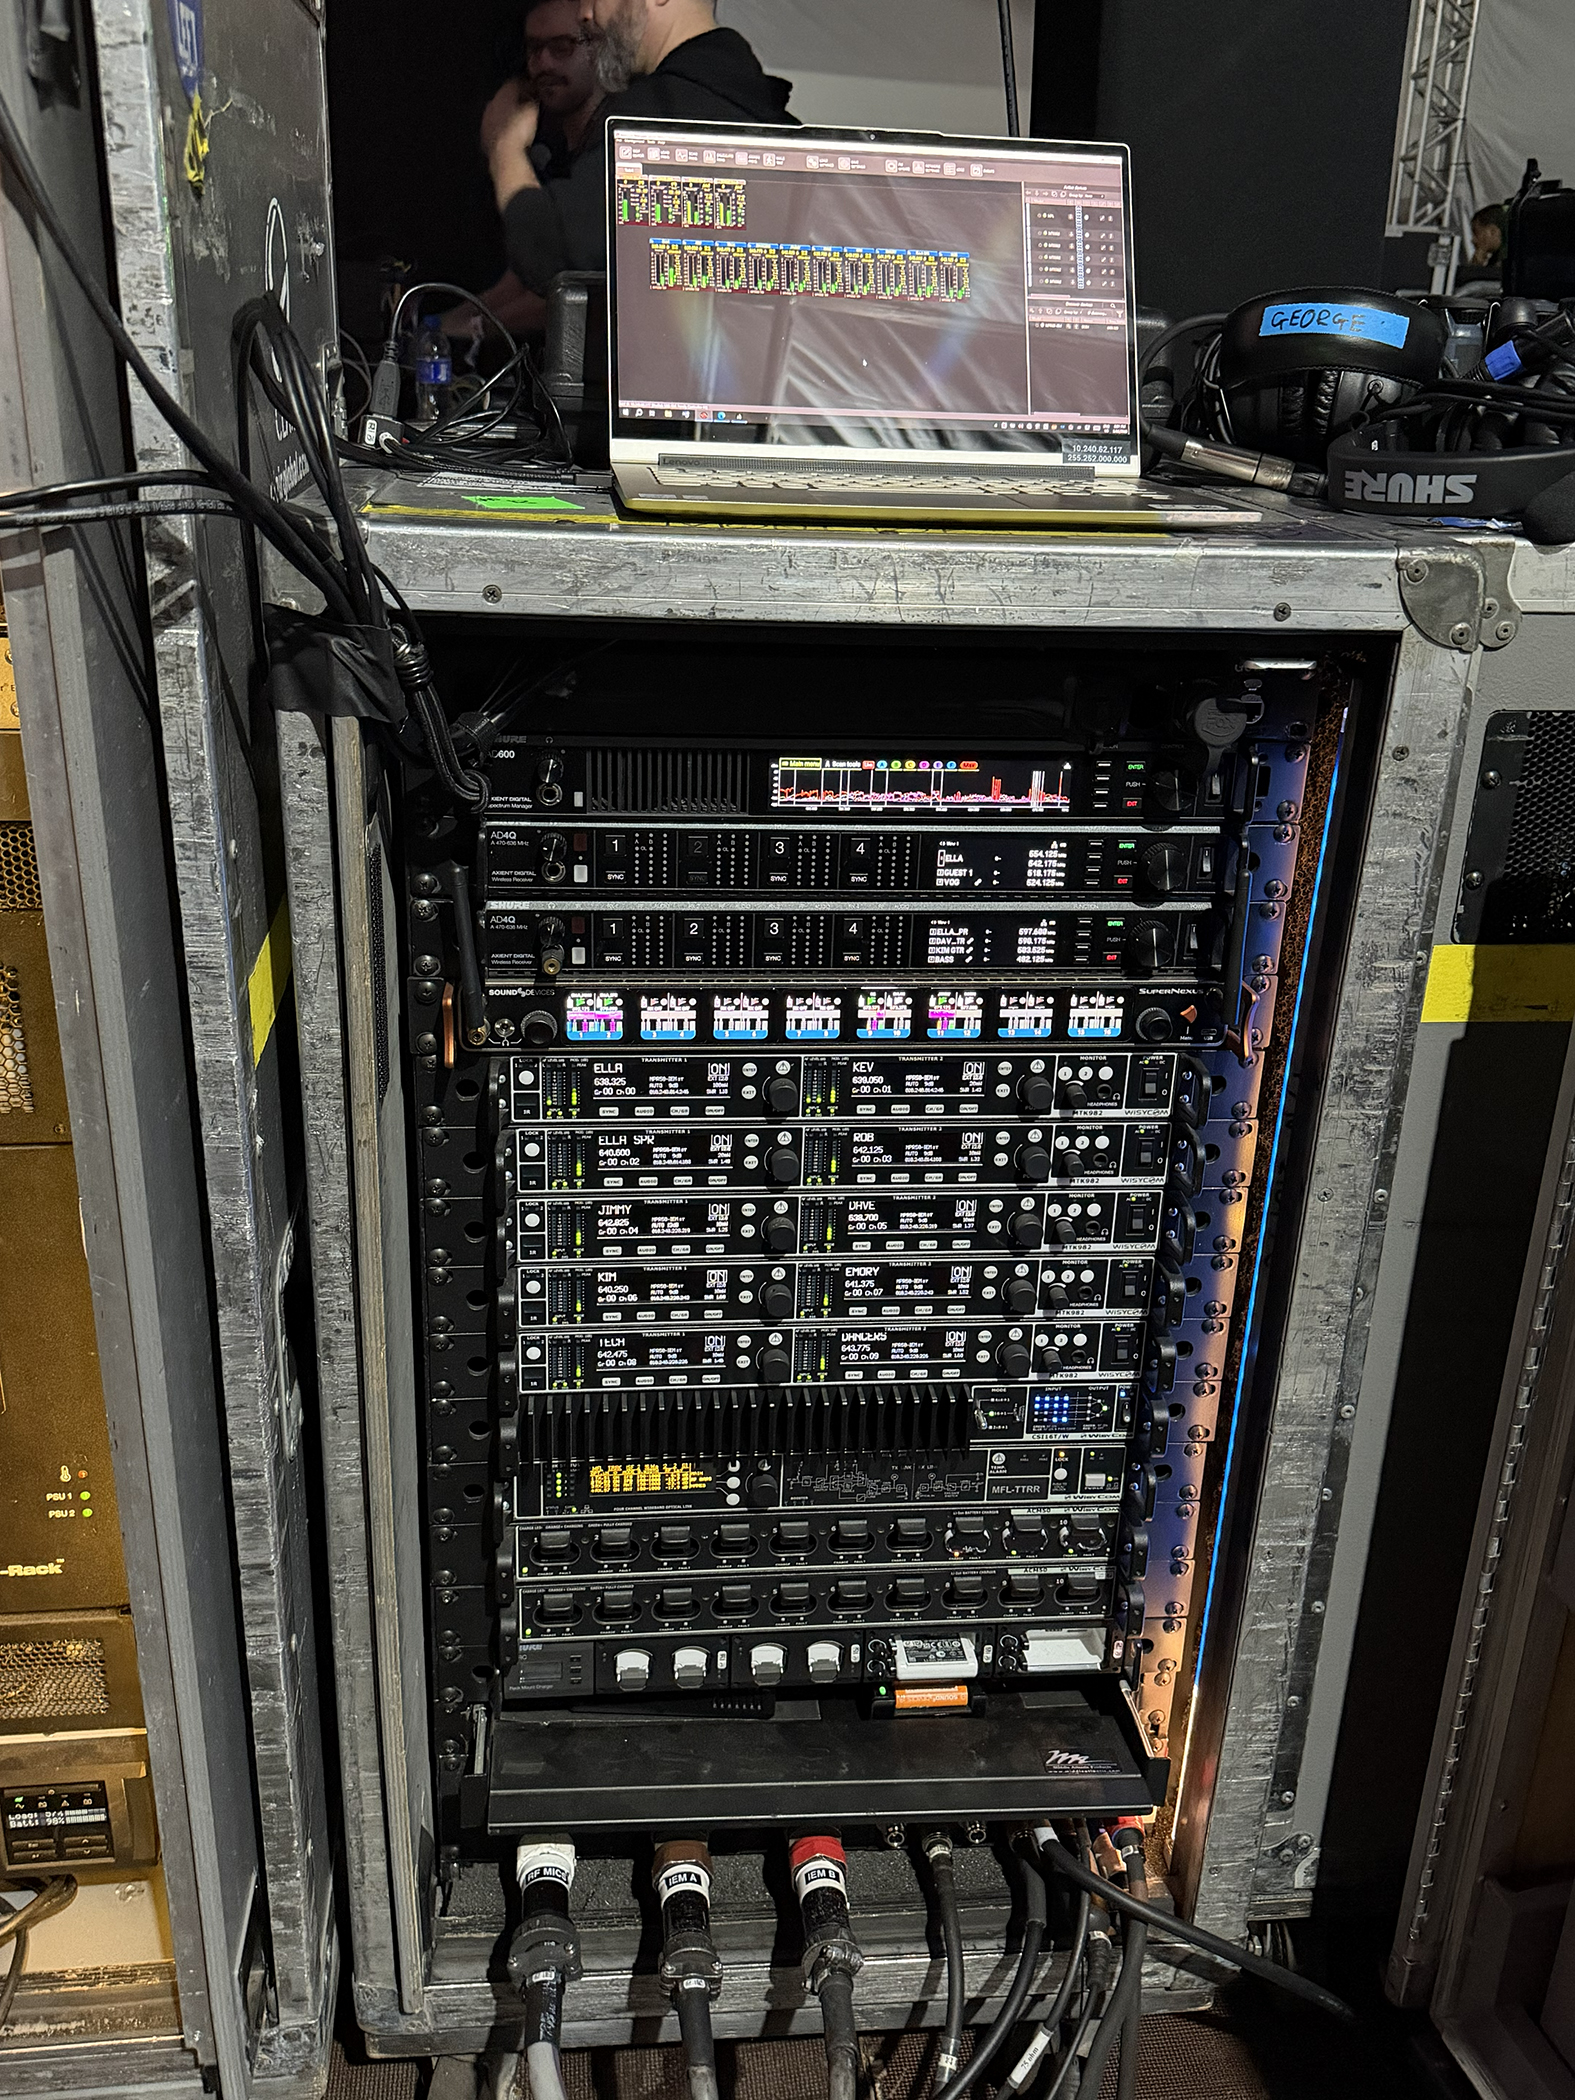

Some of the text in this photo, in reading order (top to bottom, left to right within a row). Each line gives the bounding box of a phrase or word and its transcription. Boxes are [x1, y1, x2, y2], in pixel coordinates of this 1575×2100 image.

[1270, 309, 1366, 332] GEORGE
[1073, 445, 1122, 453] 10.240.62.117
[1068, 454, 1127, 463] 255.252.000.000
[1344, 469, 1477, 504] SHURE
[491, 831, 517, 839] AD4Q
[611, 840, 618, 851] 1
[693, 841, 703, 853] 2
[775, 842, 784, 854] 3
[856, 843, 865, 854] 4
[610, 923, 616, 934] 1
[689, 923, 698, 935] 2
[770, 923, 779, 935] 3
[849, 923, 858, 934] 4
[594, 1063, 623, 1074] ELLA
[710, 1064, 728, 1074] ON
[853, 1062, 874, 1072] KEV
[965, 1063, 982, 1073] ON
[598, 1135, 730, 1146] ELLA SPR ON
[853, 1133, 982, 1143] ROB ON
[853, 1146, 883, 1154] 642.125
[598, 1204, 727, 1215] JIMMY ON
[958, 1200, 975, 1211] ON
[598, 1271, 726, 1281] KIM ON
[845, 1266, 970, 1277] EMORY ON
[707, 1336, 723, 1346] ON
[948, 1332, 964, 1342] ON
[46, 1493, 65, 1501] PSU
[49, 1510, 67, 1518] PSU
[527, 1867, 568, 1881] RF MICS
[669, 1873, 698, 1886] IEM A
[807, 1870, 836, 1881] IEM B
[1020, 2047, 1039, 2070] 75 ohm
